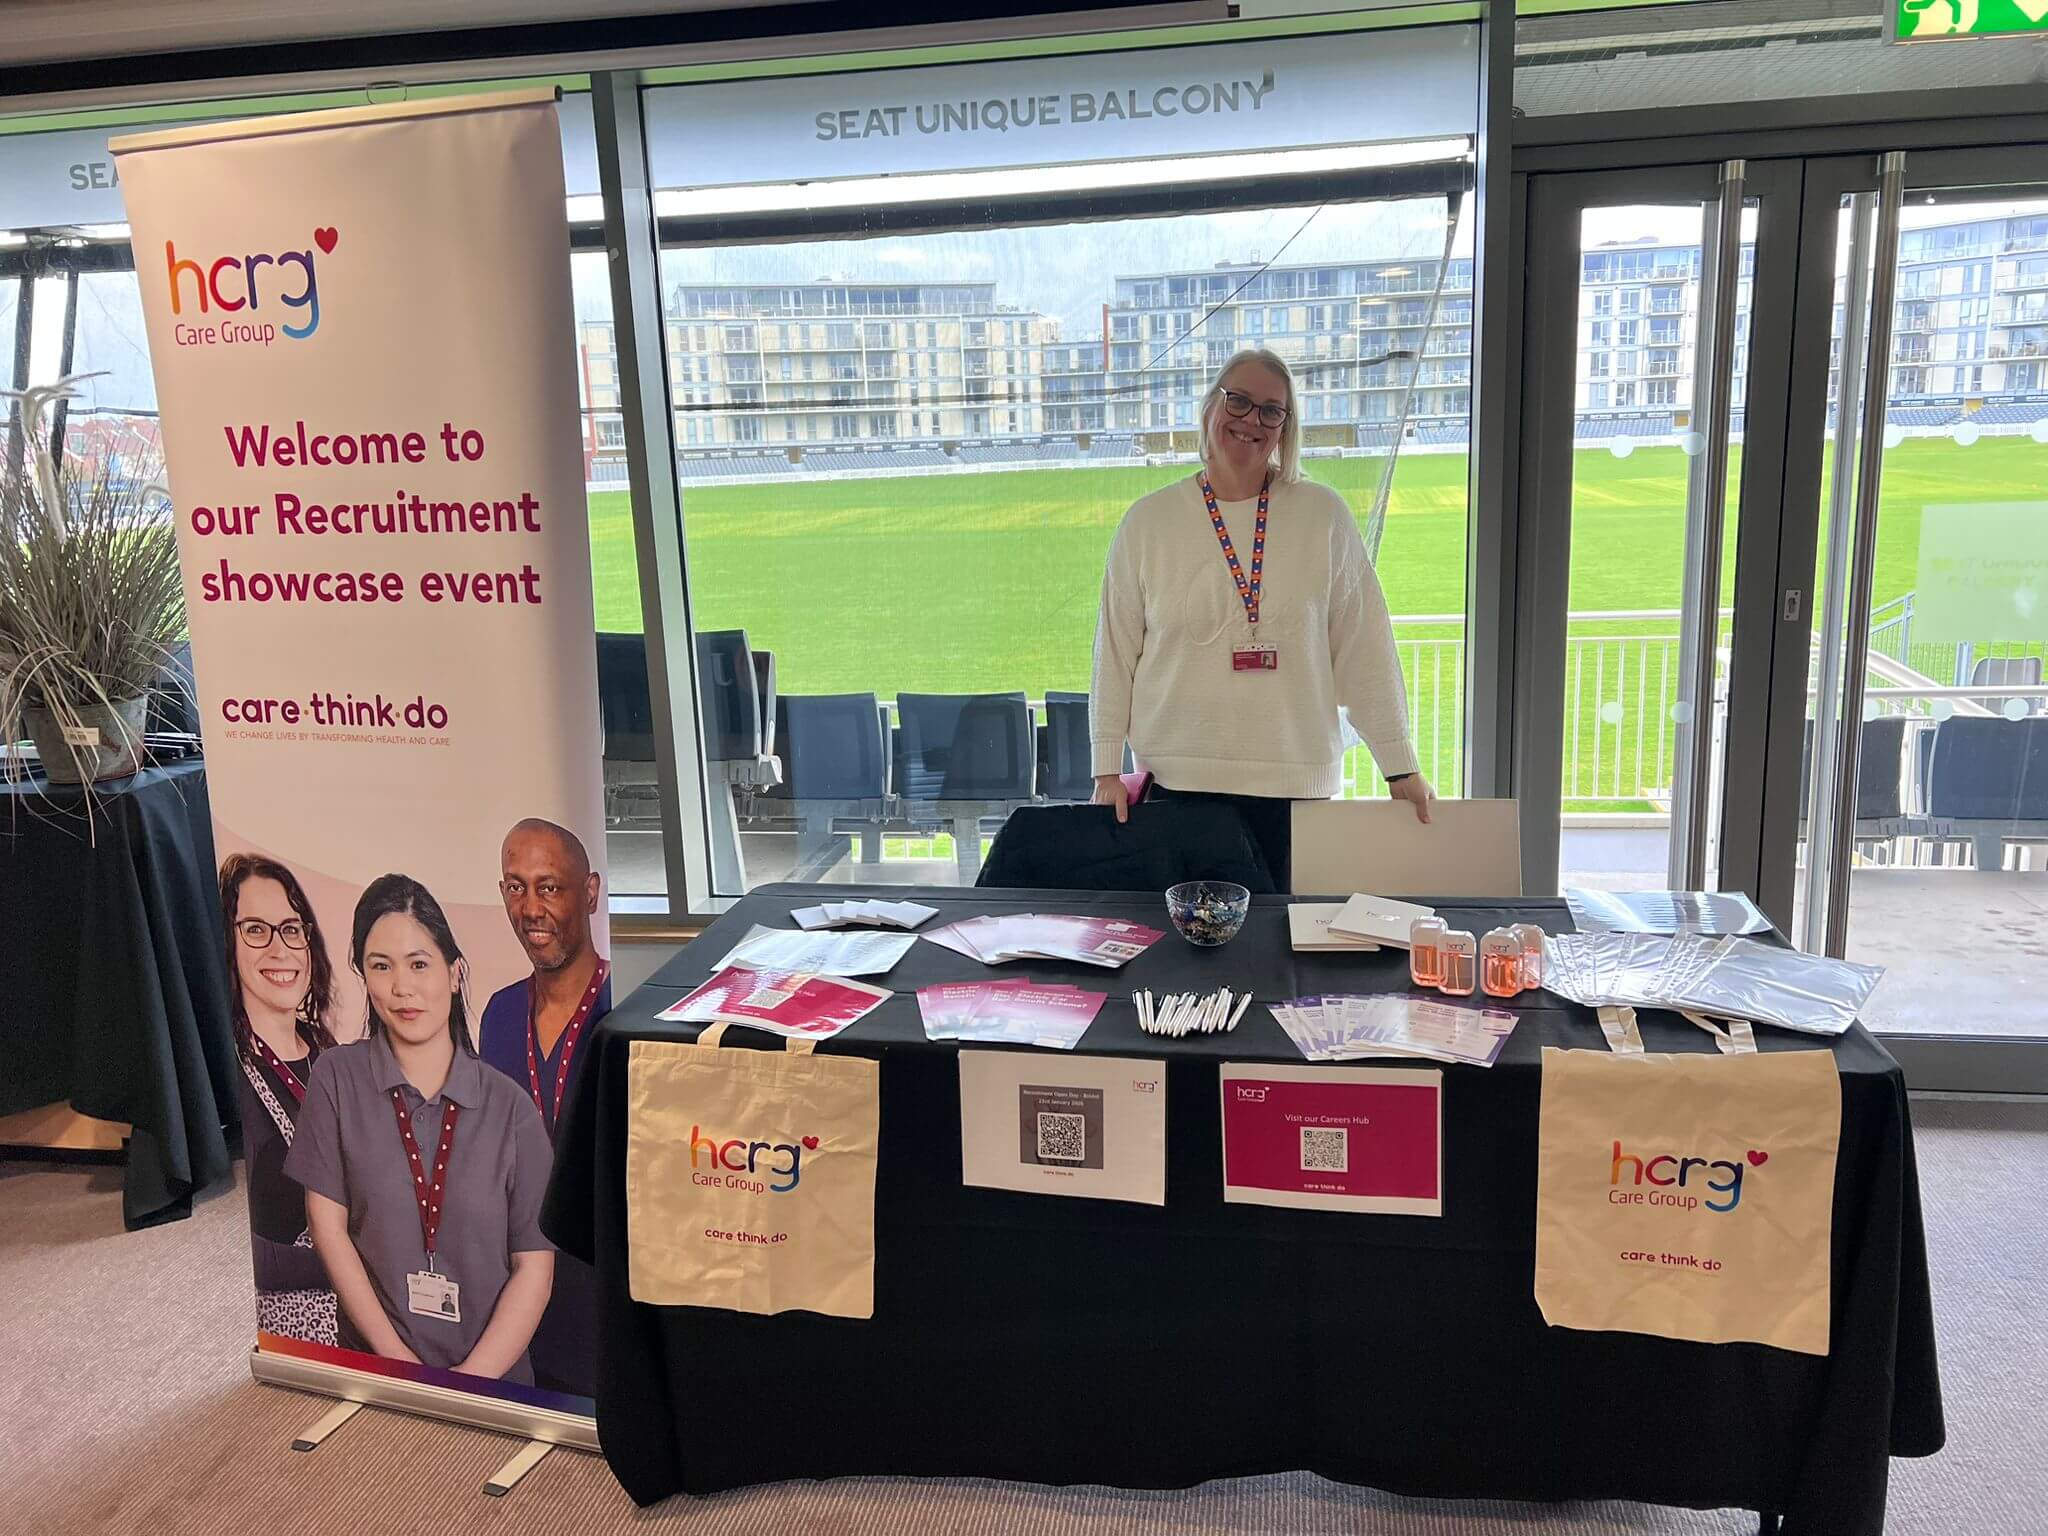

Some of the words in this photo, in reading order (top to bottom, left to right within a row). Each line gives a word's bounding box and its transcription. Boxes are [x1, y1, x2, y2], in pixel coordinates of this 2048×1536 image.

[815, 107, 907, 141] SEAT
[915, 95, 1061, 133] UNIQUE
[1070, 79, 1267, 123] BALCONY
[165, 239, 319, 339] hcrg
[175, 323, 217, 346] Care
[220, 321, 275, 347] Group
[223, 421, 426, 467] Welcome
[440, 422, 485, 462] to
[191, 505, 261, 536] our
[274, 489, 541, 535] Recruitment
[201, 558, 404, 602] showcase
[420, 564, 542, 604] event
[224, 730, 238, 739] WE
[240, 730, 273, 741] CHANGE
[276, 732, 296, 741] LIVES
[300, 732, 308, 741] BY
[312, 733, 374, 744] TRANSFORMING
[376, 735, 406, 744] HEALTH
[409, 736, 427, 745] AND
[429, 736, 450, 746] CARE
[1237, 1086, 1265, 1102] hcrg
[1285, 1114, 1302, 1122] Visit
[1304, 1115, 1318, 1123] our
[1320, 1115, 1350, 1124] Careers
[1352, 1116, 1370, 1125] Hub
[690, 1125, 801, 1192] hcrg
[1611, 1141, 1744, 1212] hcrg
[692, 1172, 722, 1188] Care
[725, 1175, 764, 1195] Group
[1608, 1189, 1644, 1205] Care
[1648, 1191, 1698, 1211] Group
